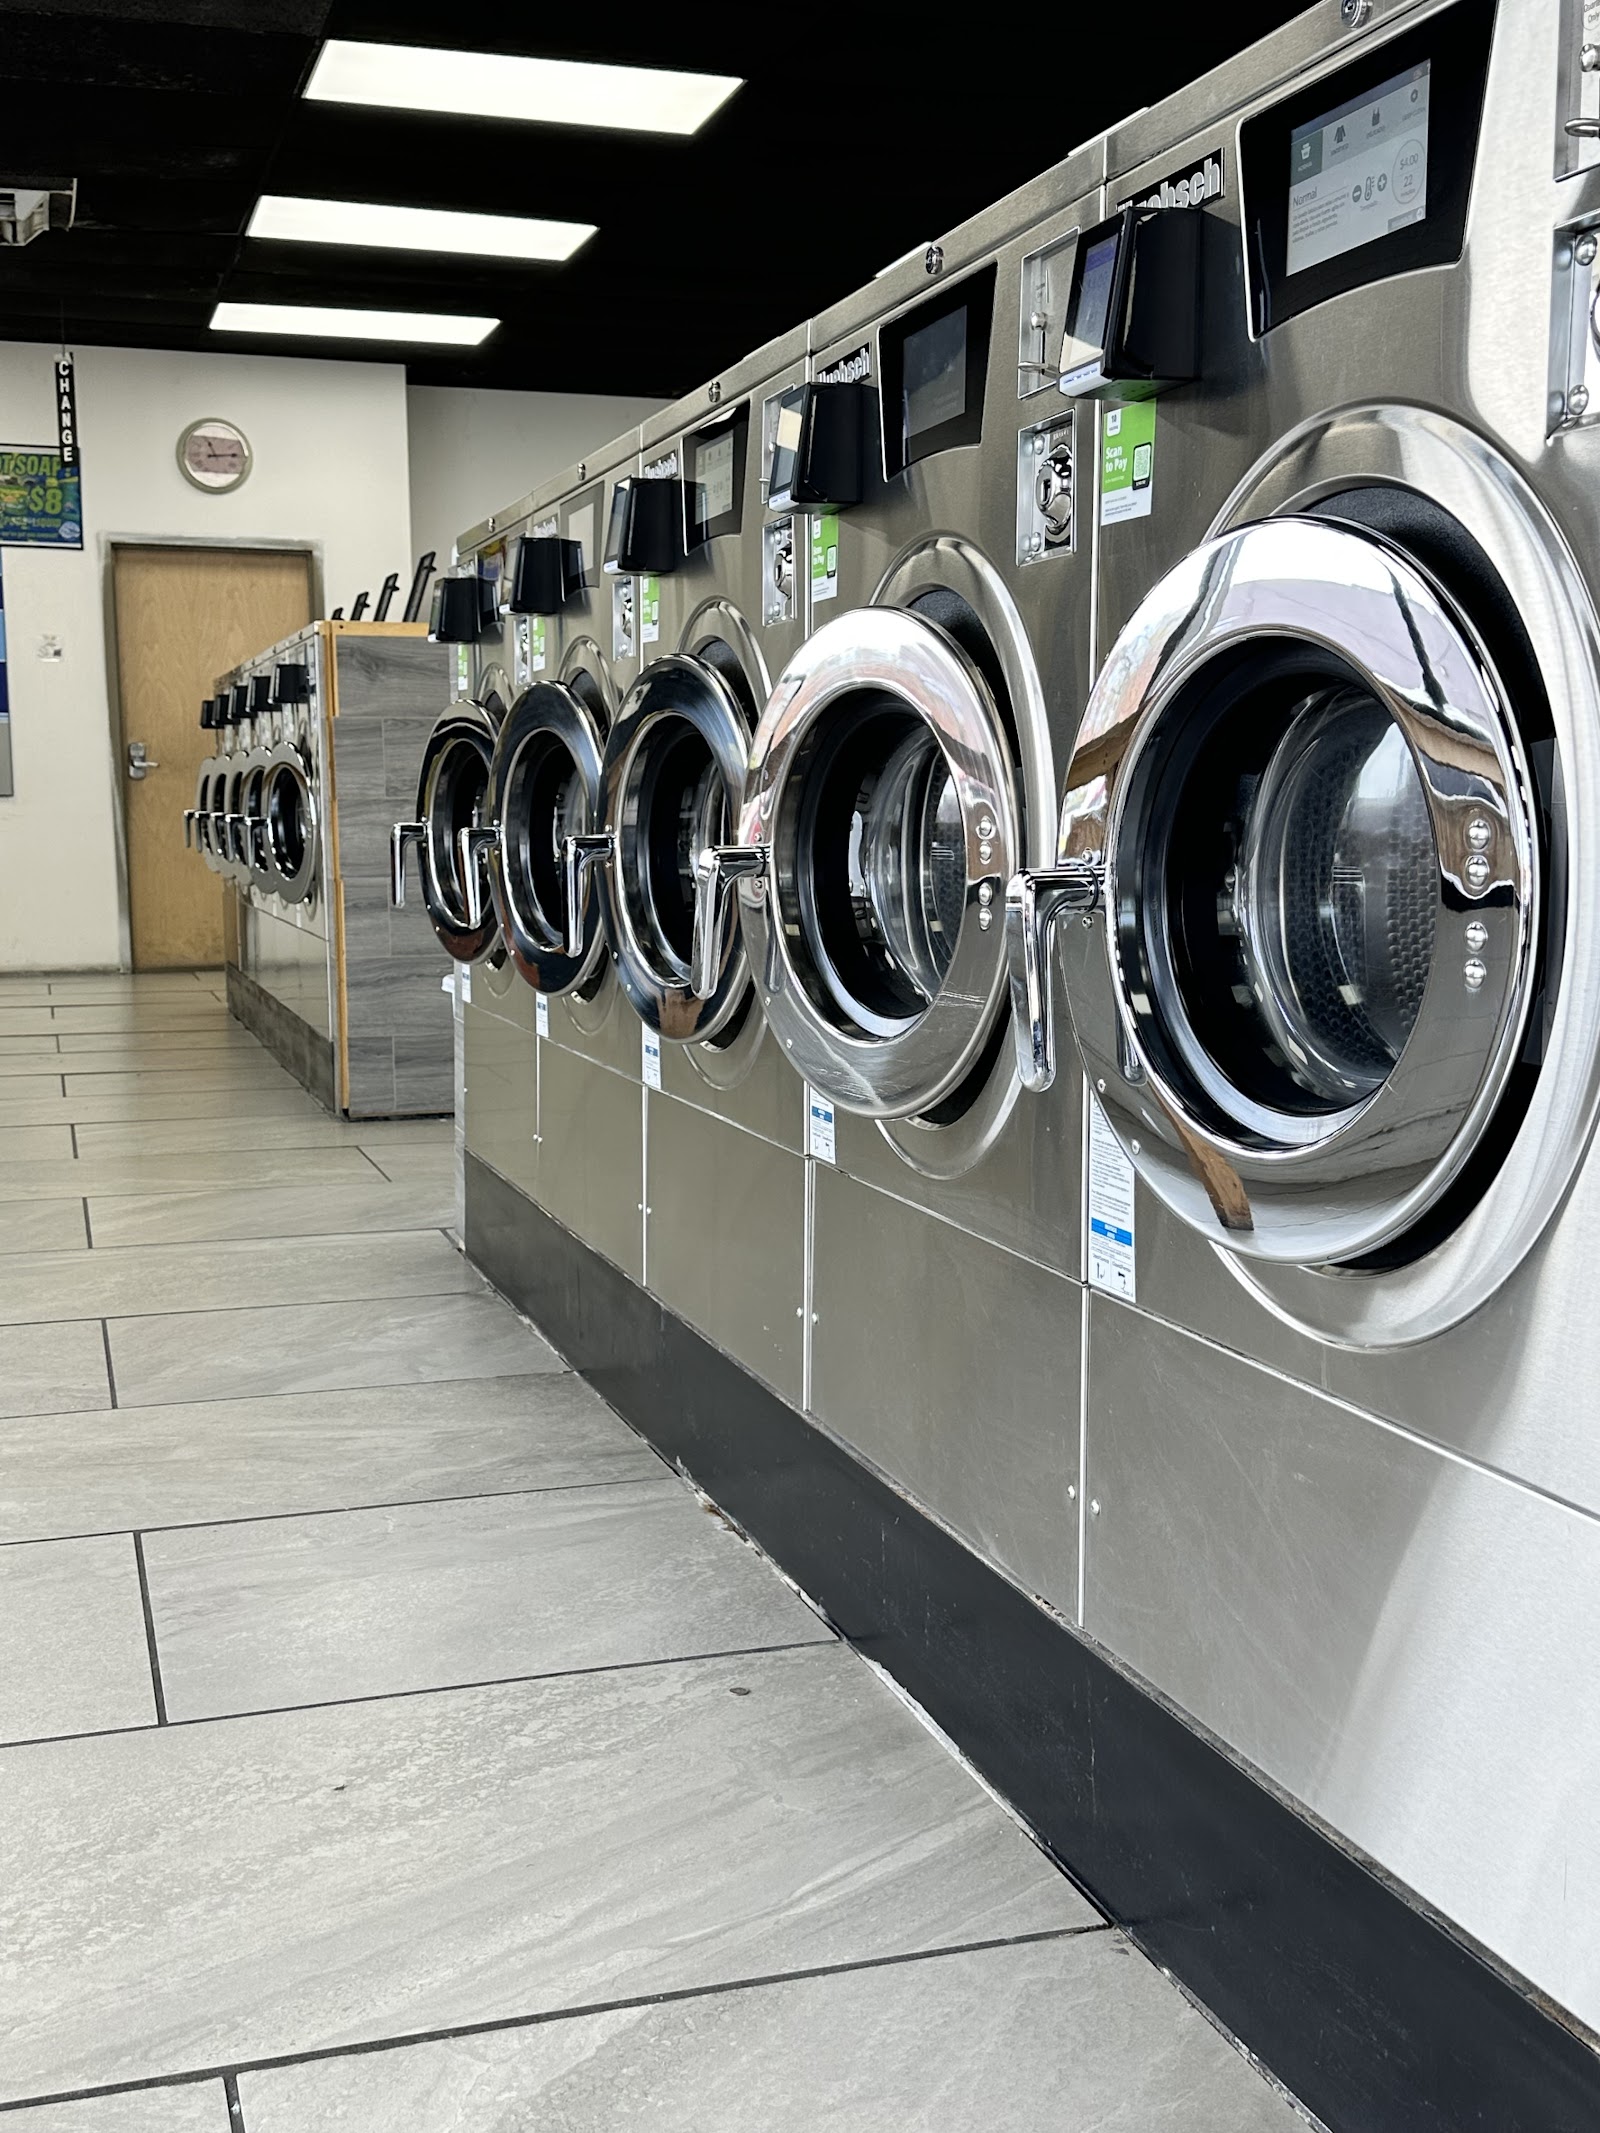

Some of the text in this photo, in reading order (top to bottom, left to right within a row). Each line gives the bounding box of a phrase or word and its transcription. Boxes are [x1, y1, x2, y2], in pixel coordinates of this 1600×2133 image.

[1403, 174, 1413, 187] 22
[1292, 186, 1318, 208] Normal
[58, 360, 73, 462] CHANGE
[1105, 446, 1123, 460] Scan
[1105, 457, 1128, 474] to Pay
[29, 486, 62, 515] $8
